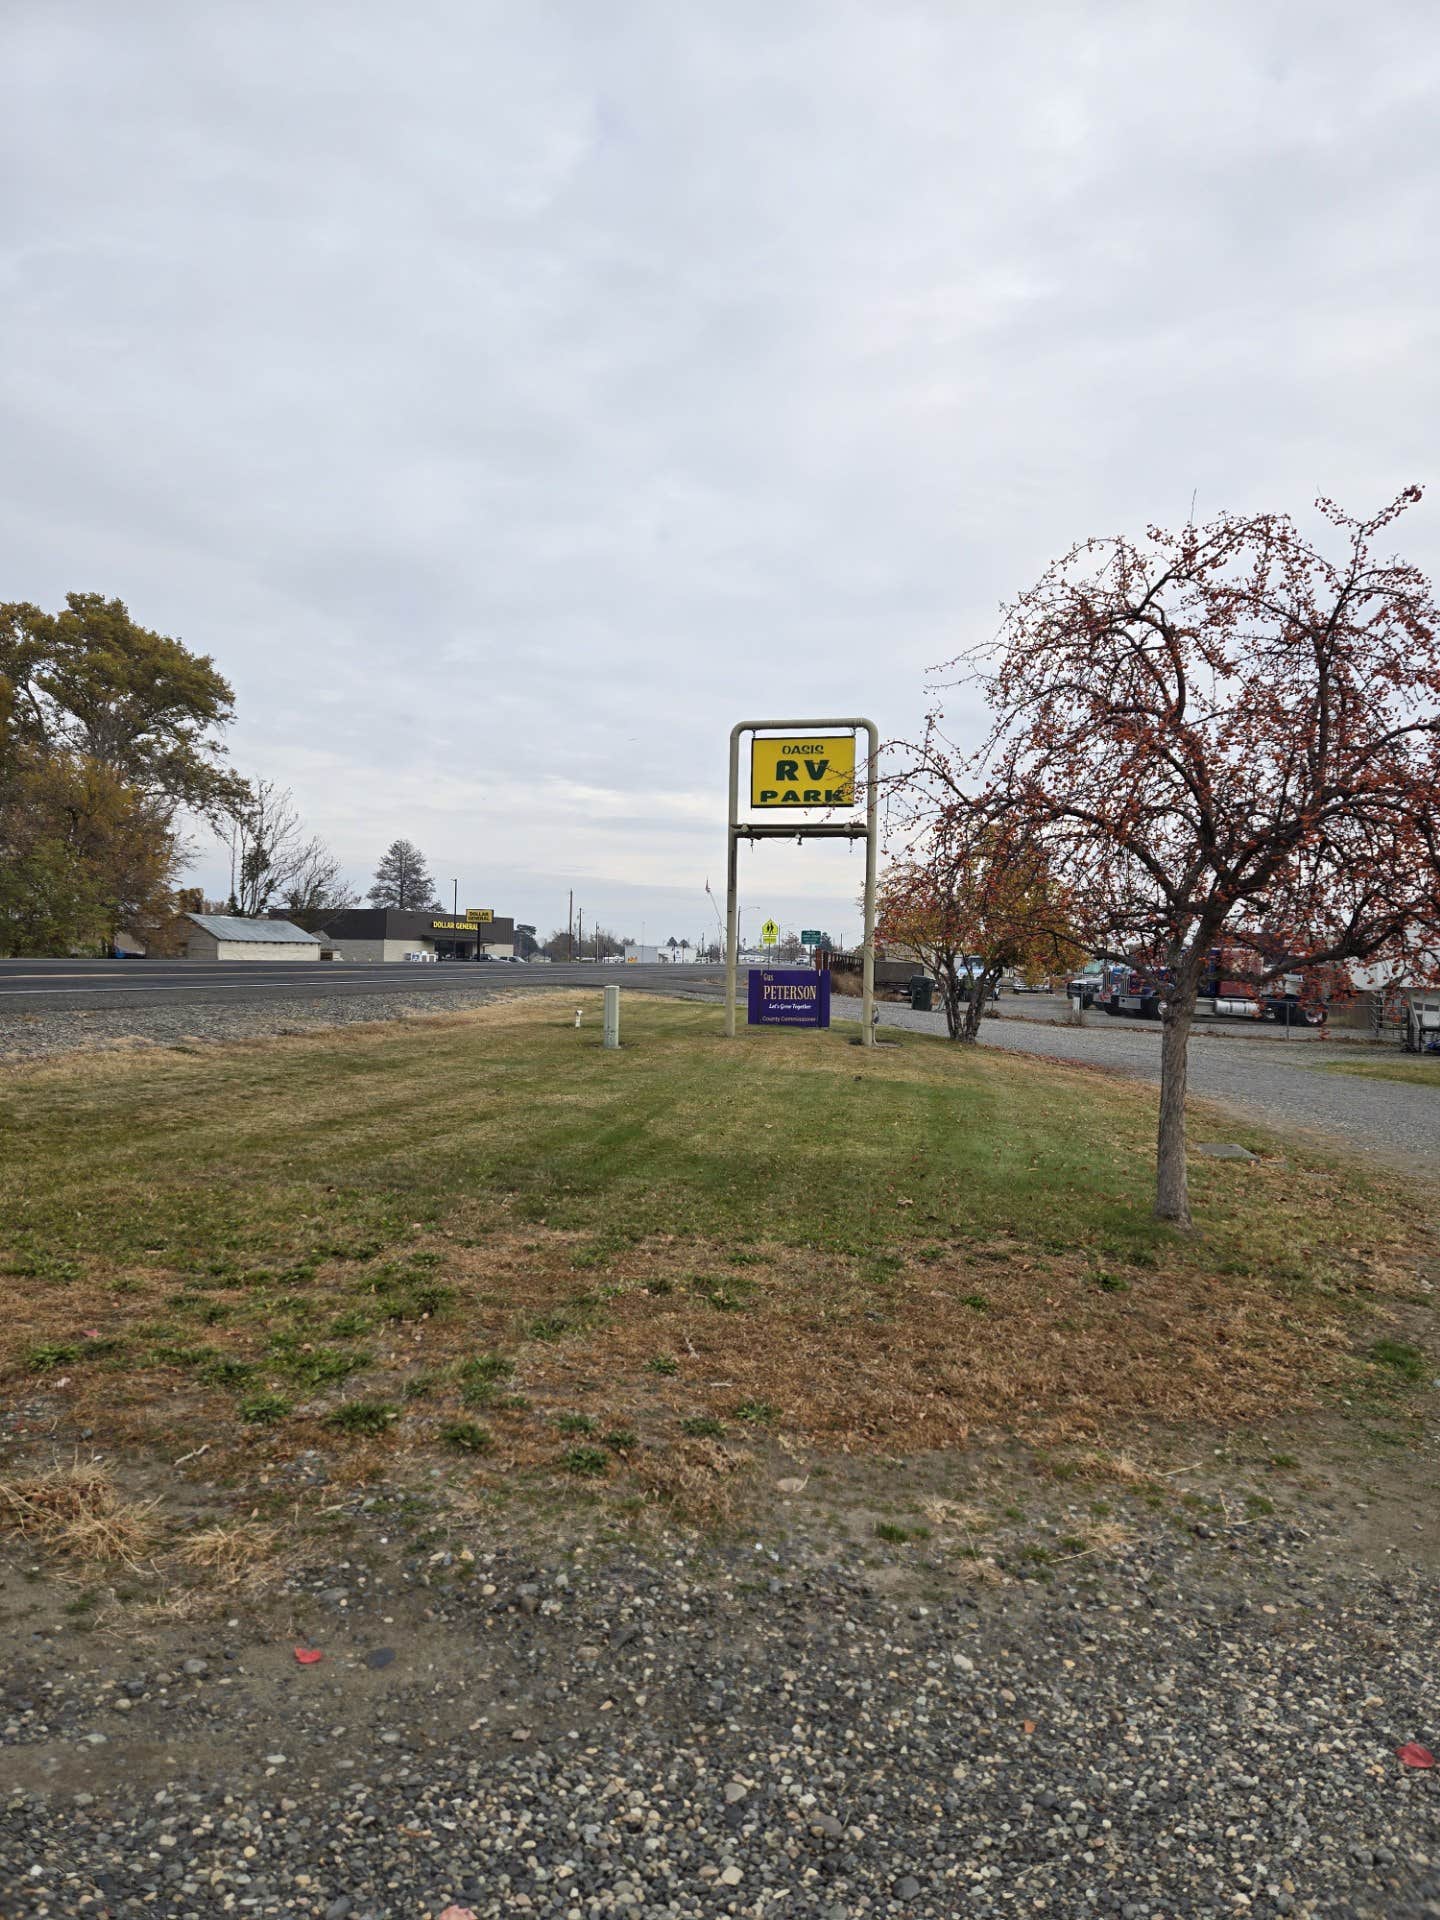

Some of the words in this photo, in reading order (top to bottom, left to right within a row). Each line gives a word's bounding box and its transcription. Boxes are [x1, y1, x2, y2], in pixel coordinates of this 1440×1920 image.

[782, 745, 824, 754] OASIS
[776, 760, 830, 781] RV
[760, 789, 844, 802] PARK
[433, 921, 455, 929] DOLLAR
[455, 922, 479, 931] GENERAL
[763, 985, 816, 1000] PETERSON
